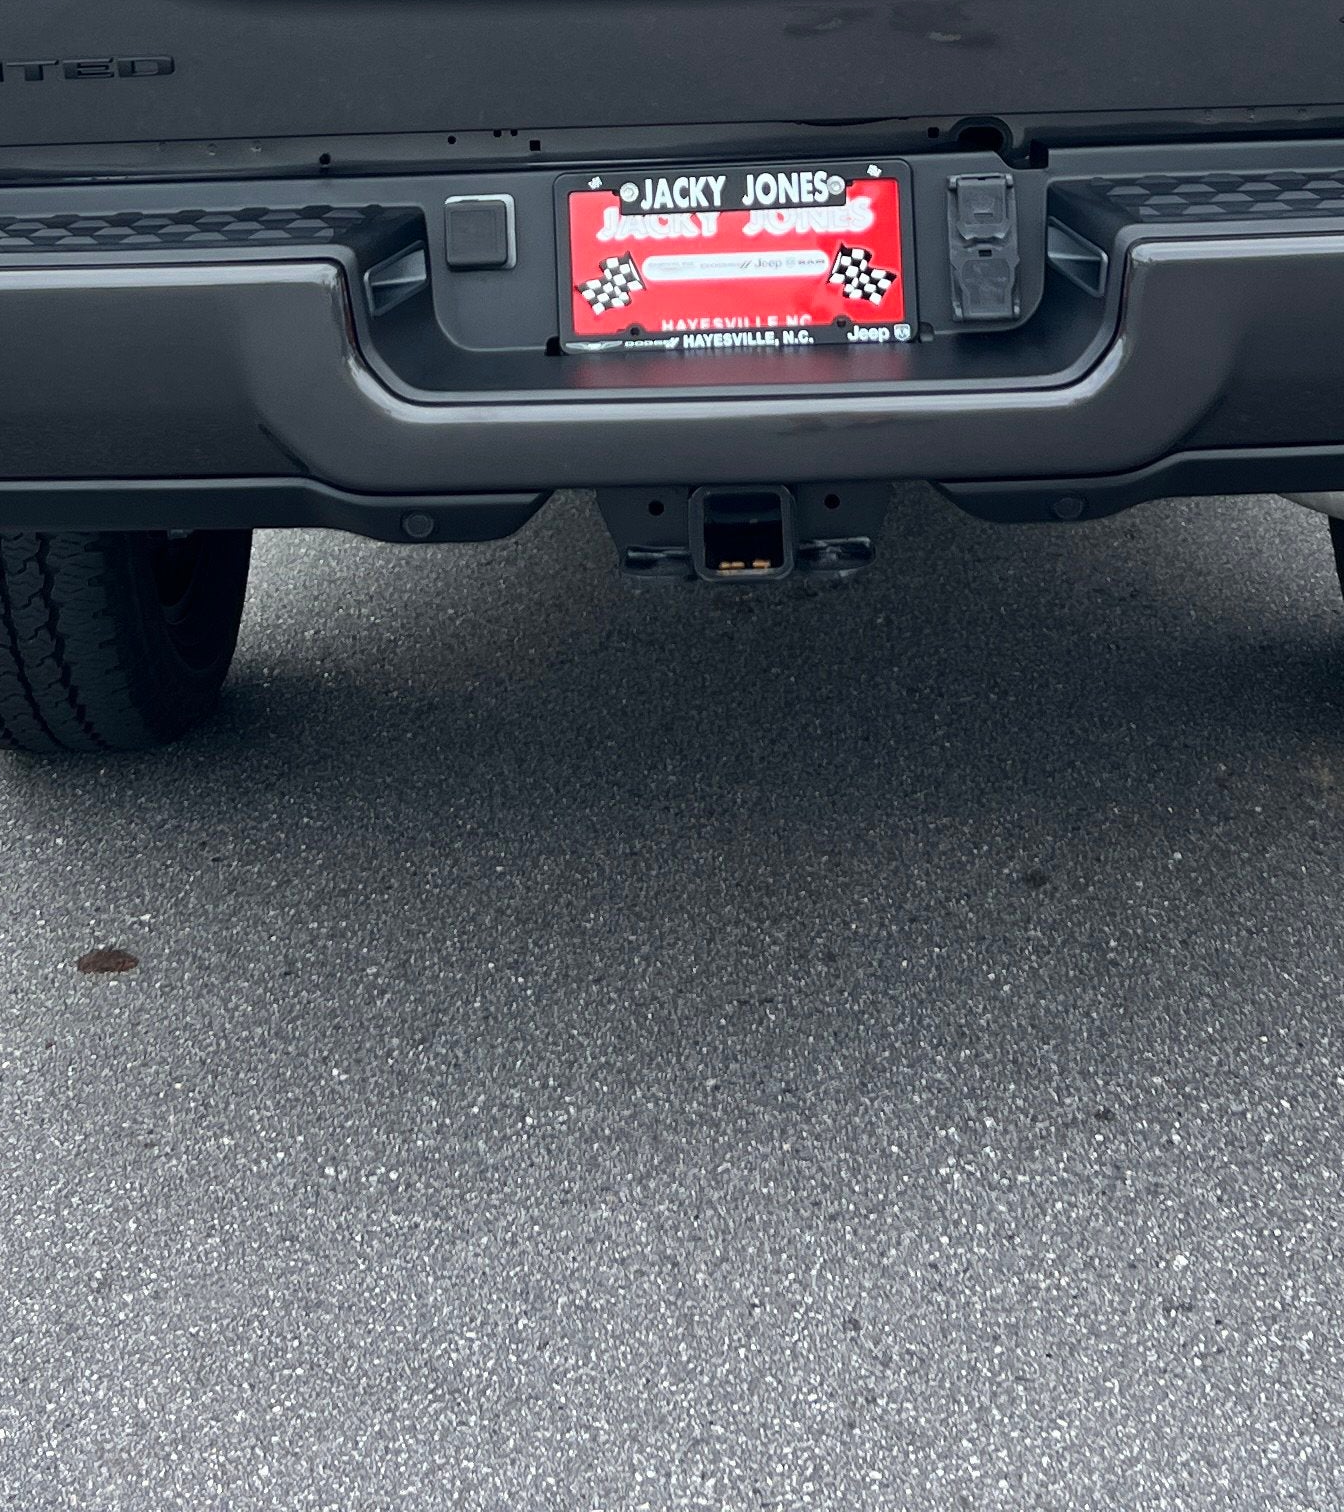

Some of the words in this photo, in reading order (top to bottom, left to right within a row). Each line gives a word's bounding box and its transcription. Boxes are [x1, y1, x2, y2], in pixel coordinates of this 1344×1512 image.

[640, 175, 727, 211] JACKY
[742, 171, 829, 206] JONES
[682, 330, 780, 348] HAYESVILLE,
[782, 328, 814, 345] N.C.
[847, 324, 890, 345] Jeep
